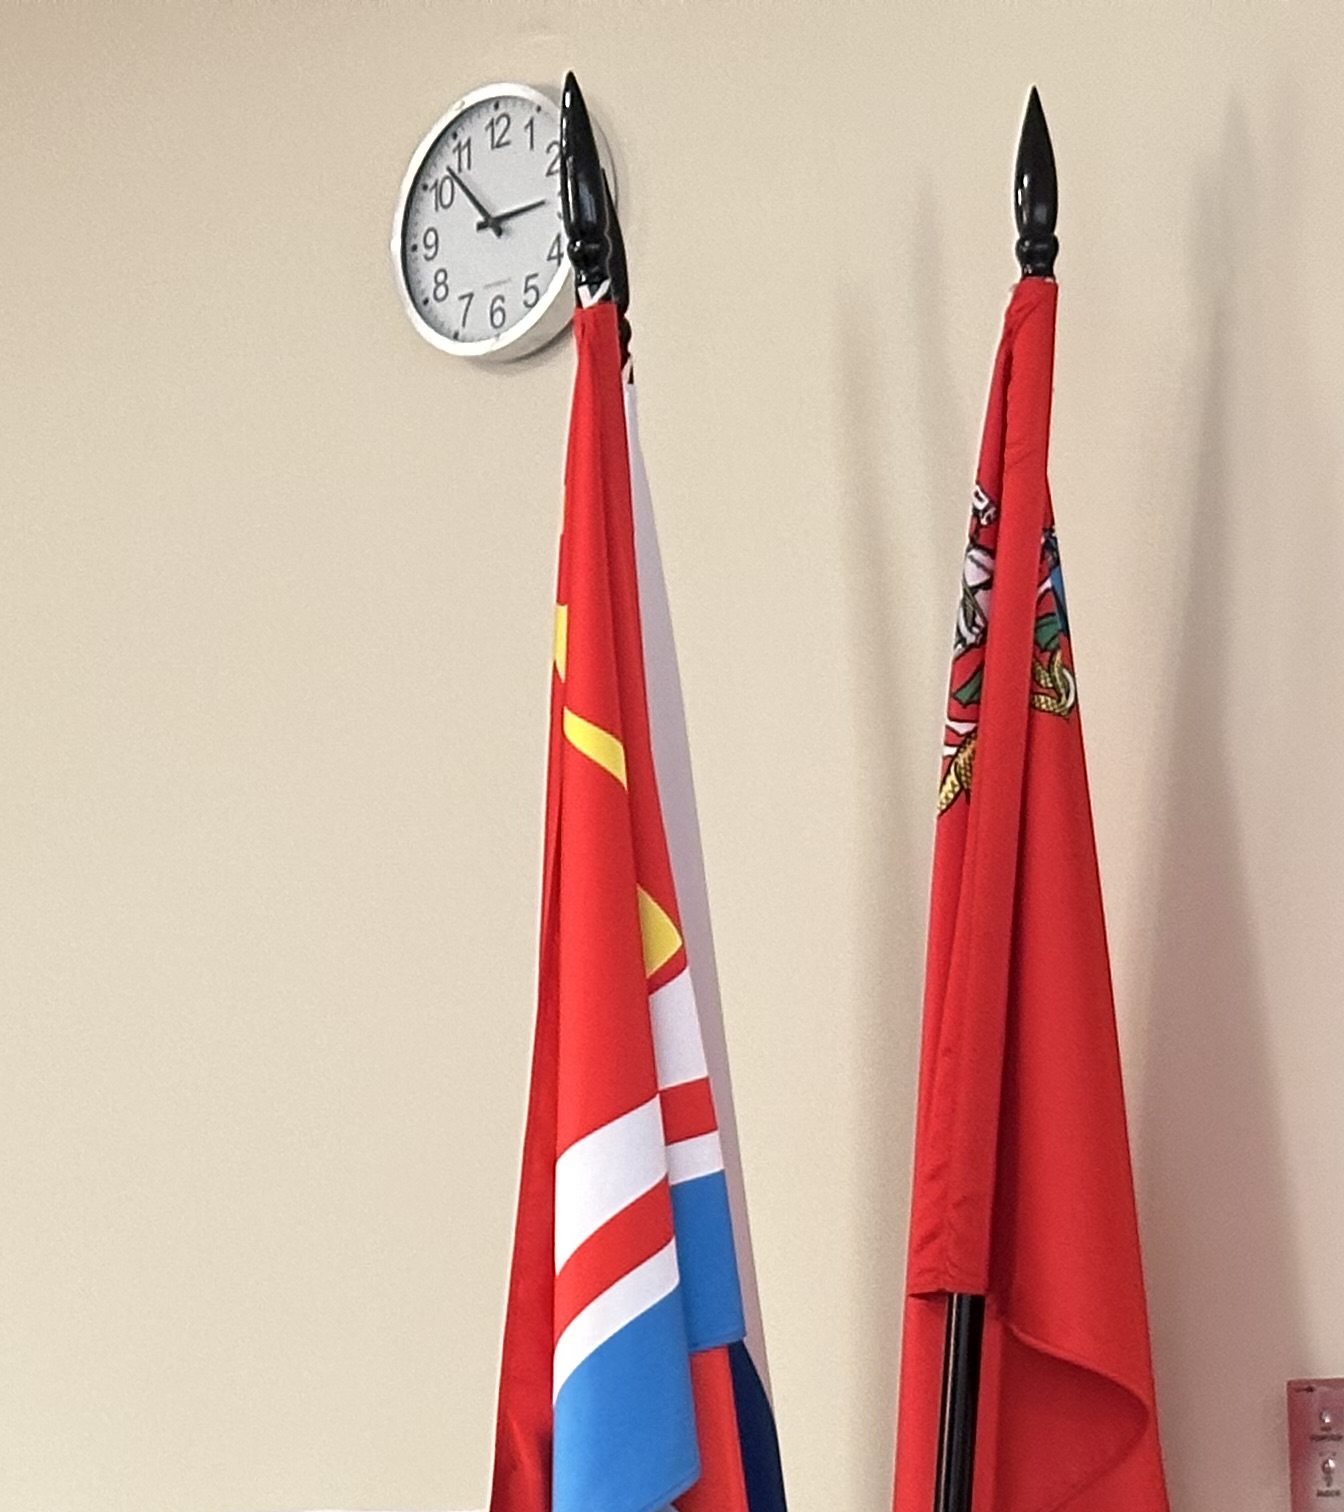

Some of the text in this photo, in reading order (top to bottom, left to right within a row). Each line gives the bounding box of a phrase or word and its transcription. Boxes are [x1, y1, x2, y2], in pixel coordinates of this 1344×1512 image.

[485, 113, 511, 150] 12
[524, 117, 535, 151] 1
[452, 136, 472, 171] 11
[545, 140, 561, 177] 2
[429, 175, 455, 213] 10
[422, 227, 439, 261] 9
[546, 233, 565, 266] 4
[432, 269, 450, 303] 8
[523, 273, 540, 309] 5
[458, 293, 475, 328] 7
[489, 295, 506, 330] 6
